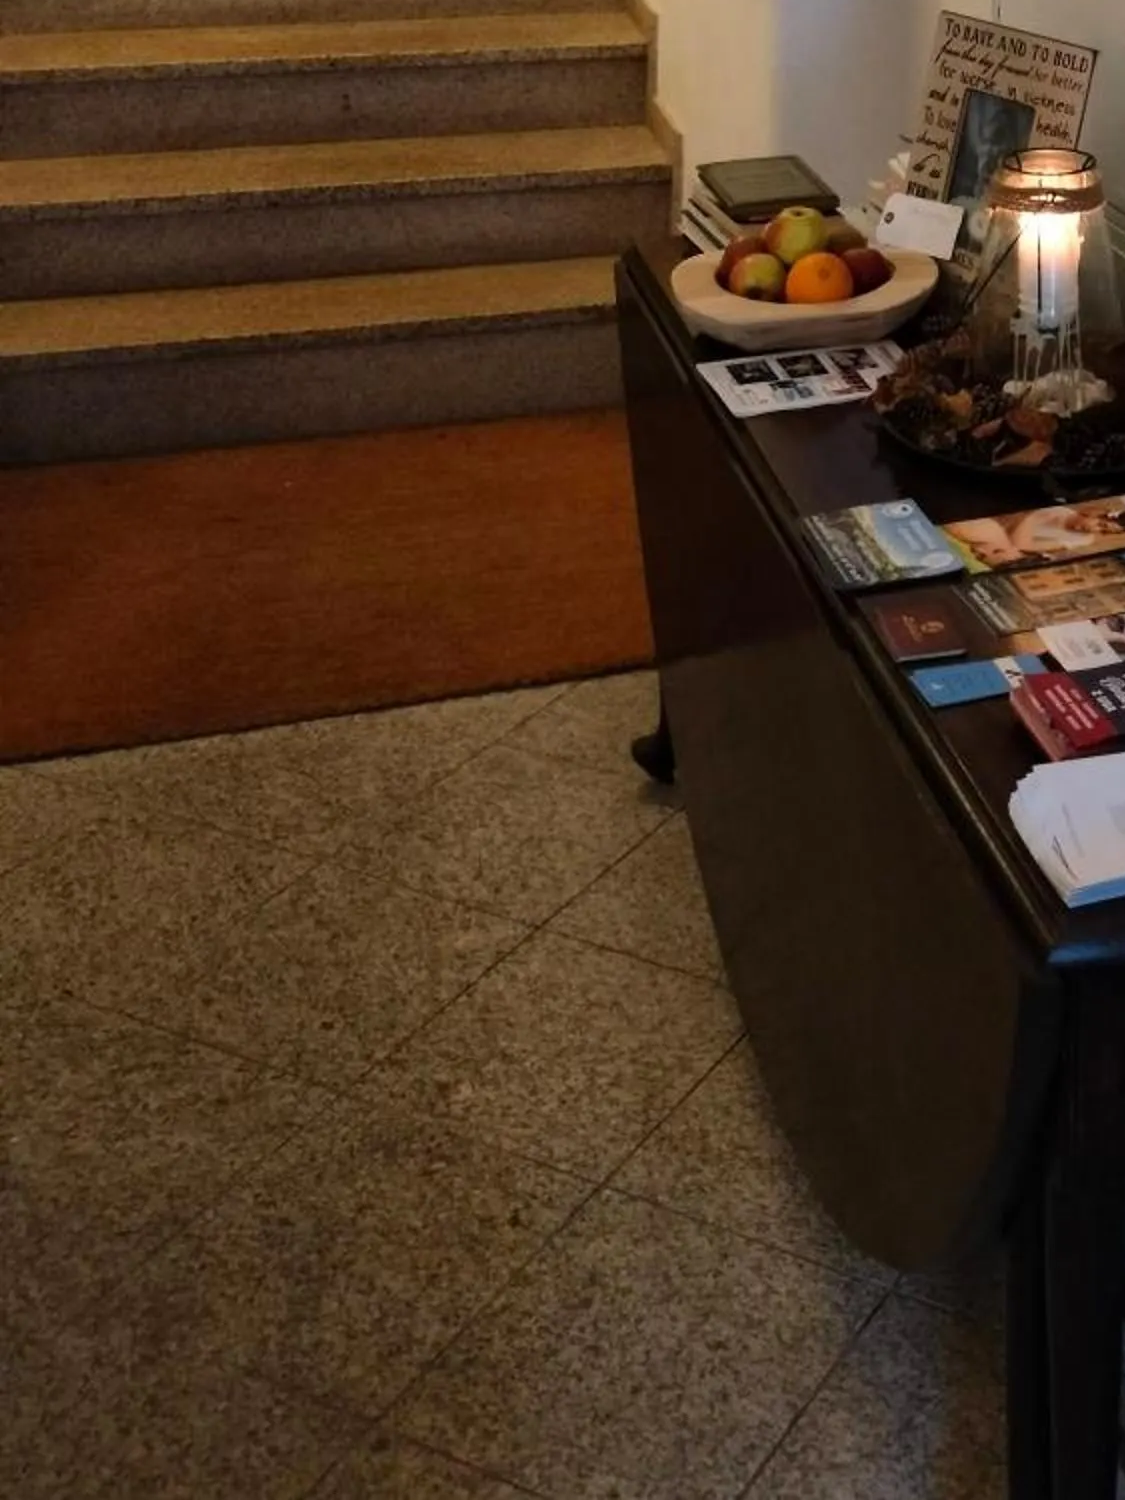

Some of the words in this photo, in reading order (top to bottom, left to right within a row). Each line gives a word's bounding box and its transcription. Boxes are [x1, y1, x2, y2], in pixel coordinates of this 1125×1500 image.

[945, 17, 960, 38] TO
[962, 24, 995, 48] HAVE
[996, 35, 1027, 57] AND
[1032, 43, 1049, 63] TO
[1053, 49, 1089, 73] HOLD
